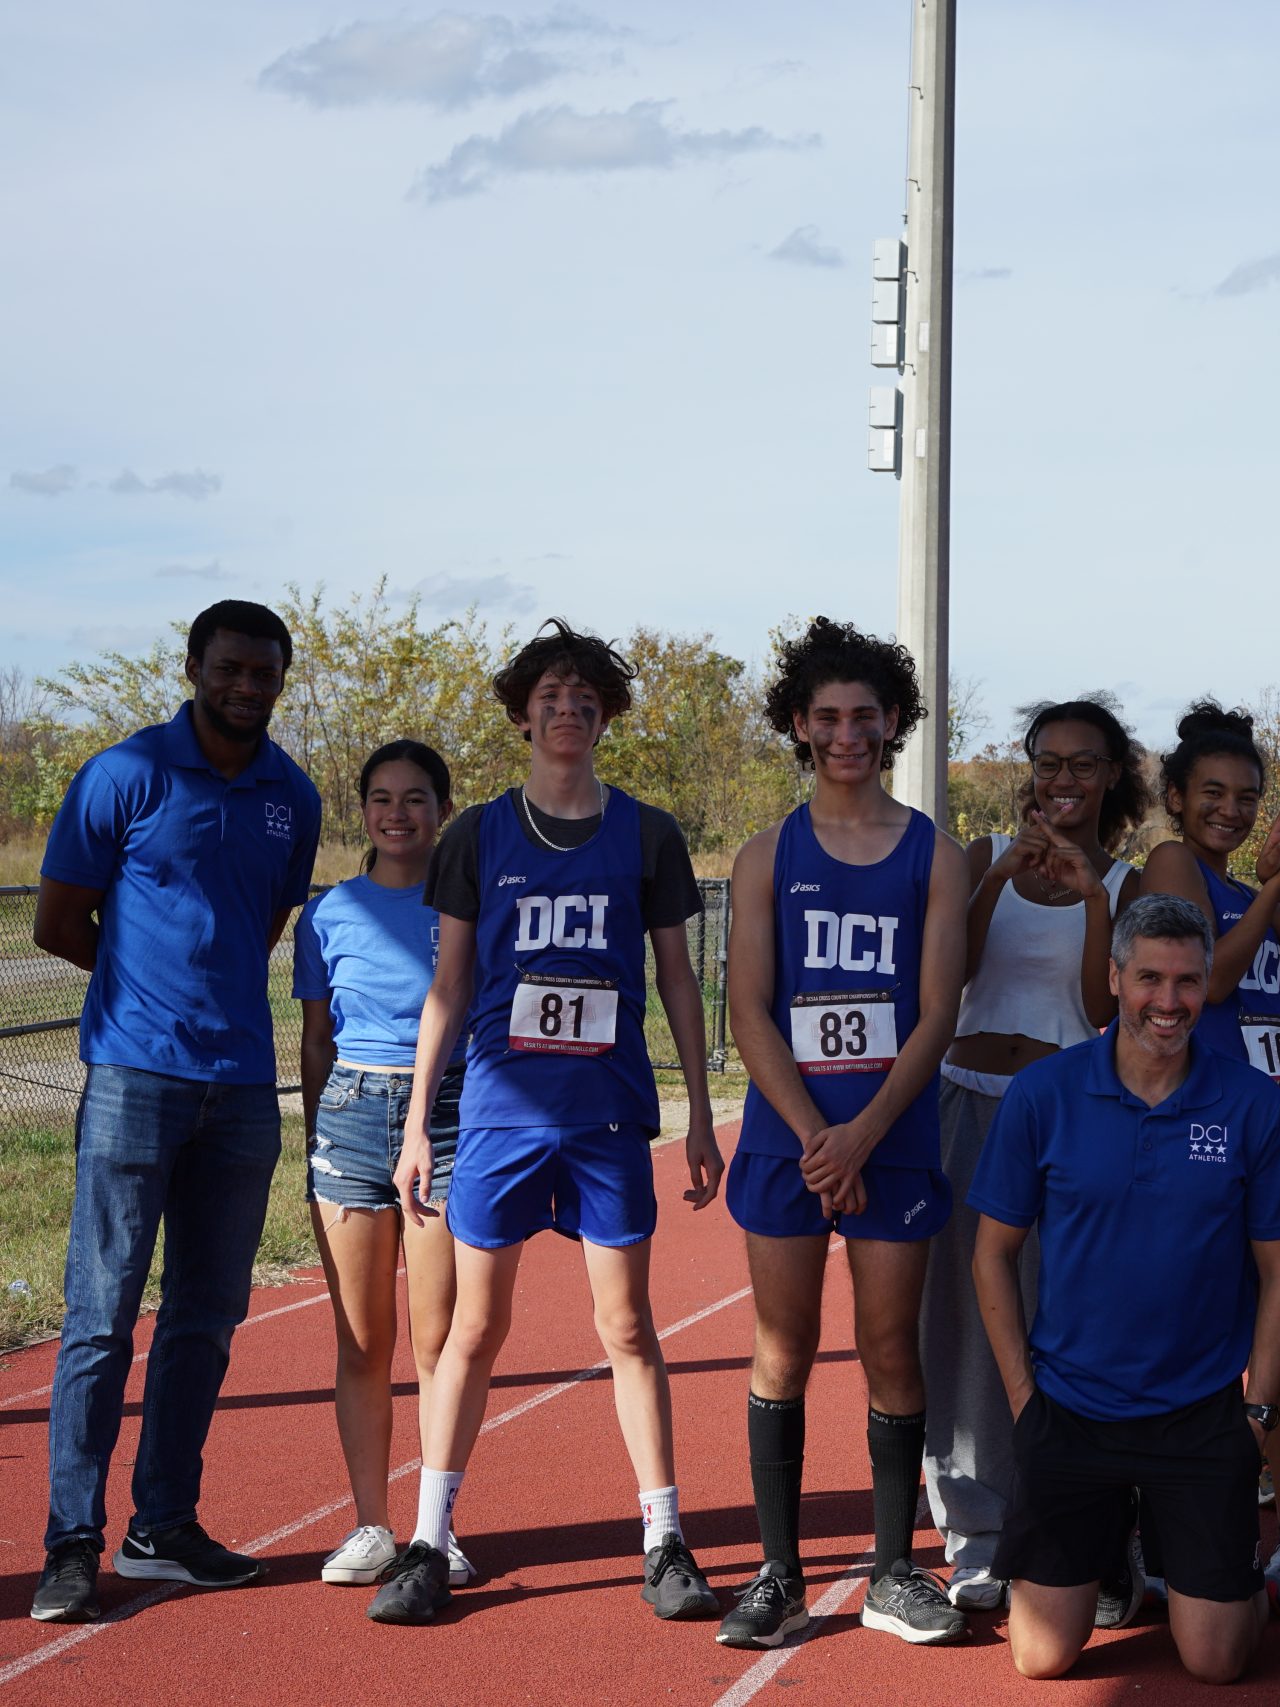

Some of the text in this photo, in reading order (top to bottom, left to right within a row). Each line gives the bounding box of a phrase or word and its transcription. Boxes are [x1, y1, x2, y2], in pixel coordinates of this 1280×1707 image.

[265, 802, 291, 822] DCI
[515, 894, 609, 951] DCI
[804, 909, 898, 975] DCI
[539, 992, 584, 1039] 81
[820, 1010, 868, 1058] 83
[1190, 1123, 1228, 1143] DCI
[1189, 1154, 1227, 1162] ATHLETICS
